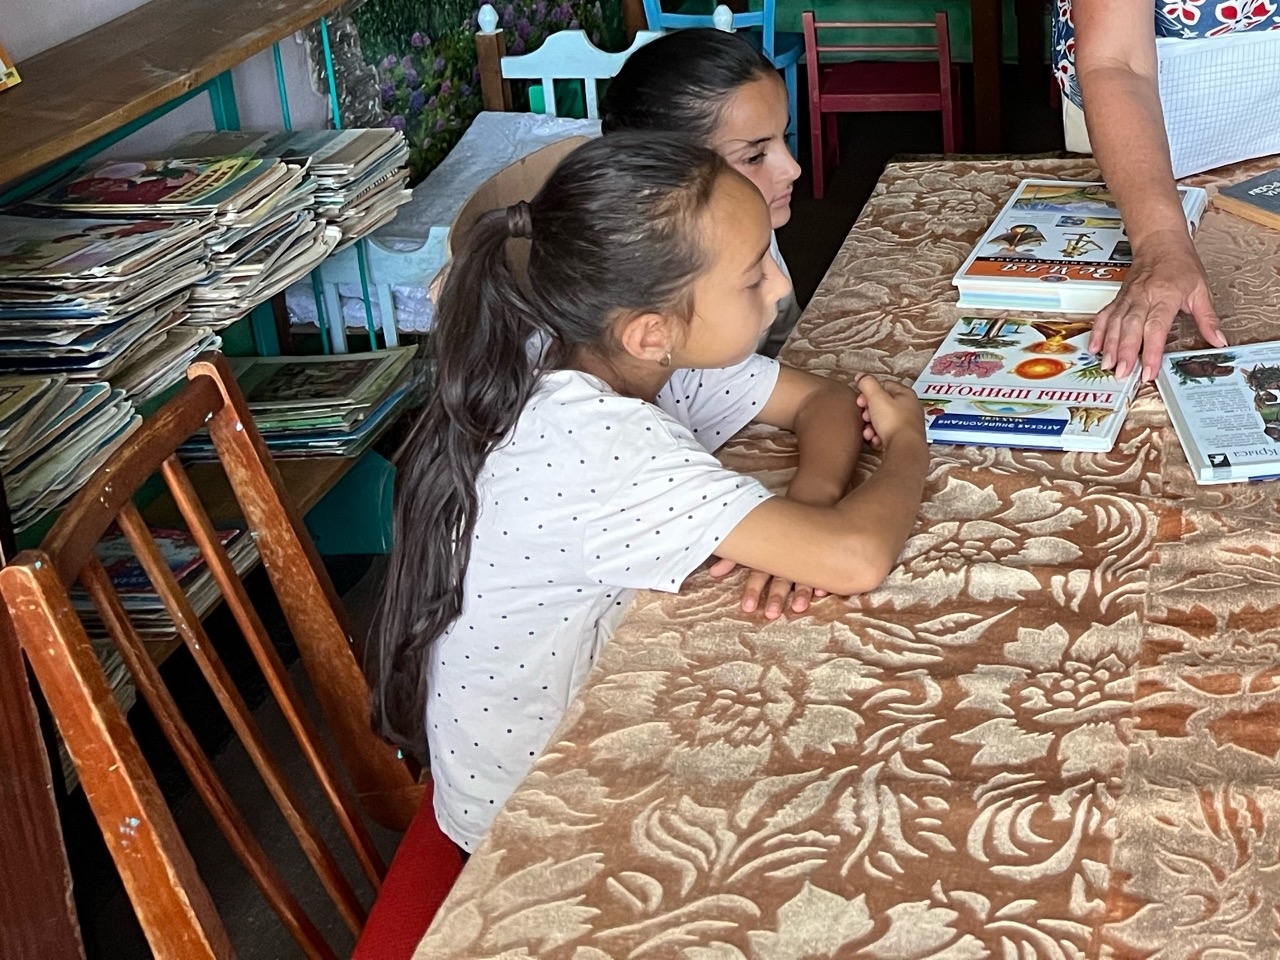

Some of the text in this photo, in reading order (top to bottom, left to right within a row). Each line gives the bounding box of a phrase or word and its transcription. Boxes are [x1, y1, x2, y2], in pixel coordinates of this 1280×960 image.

[922, 382, 1114, 405] ТАЙНЫ ПРИРОДЫ
[937, 419, 1062, 431] ДЕТСКАЯ ЭНЦИКЛОПЕДИЯ
[1232, 446, 1279, 458] Крыса
